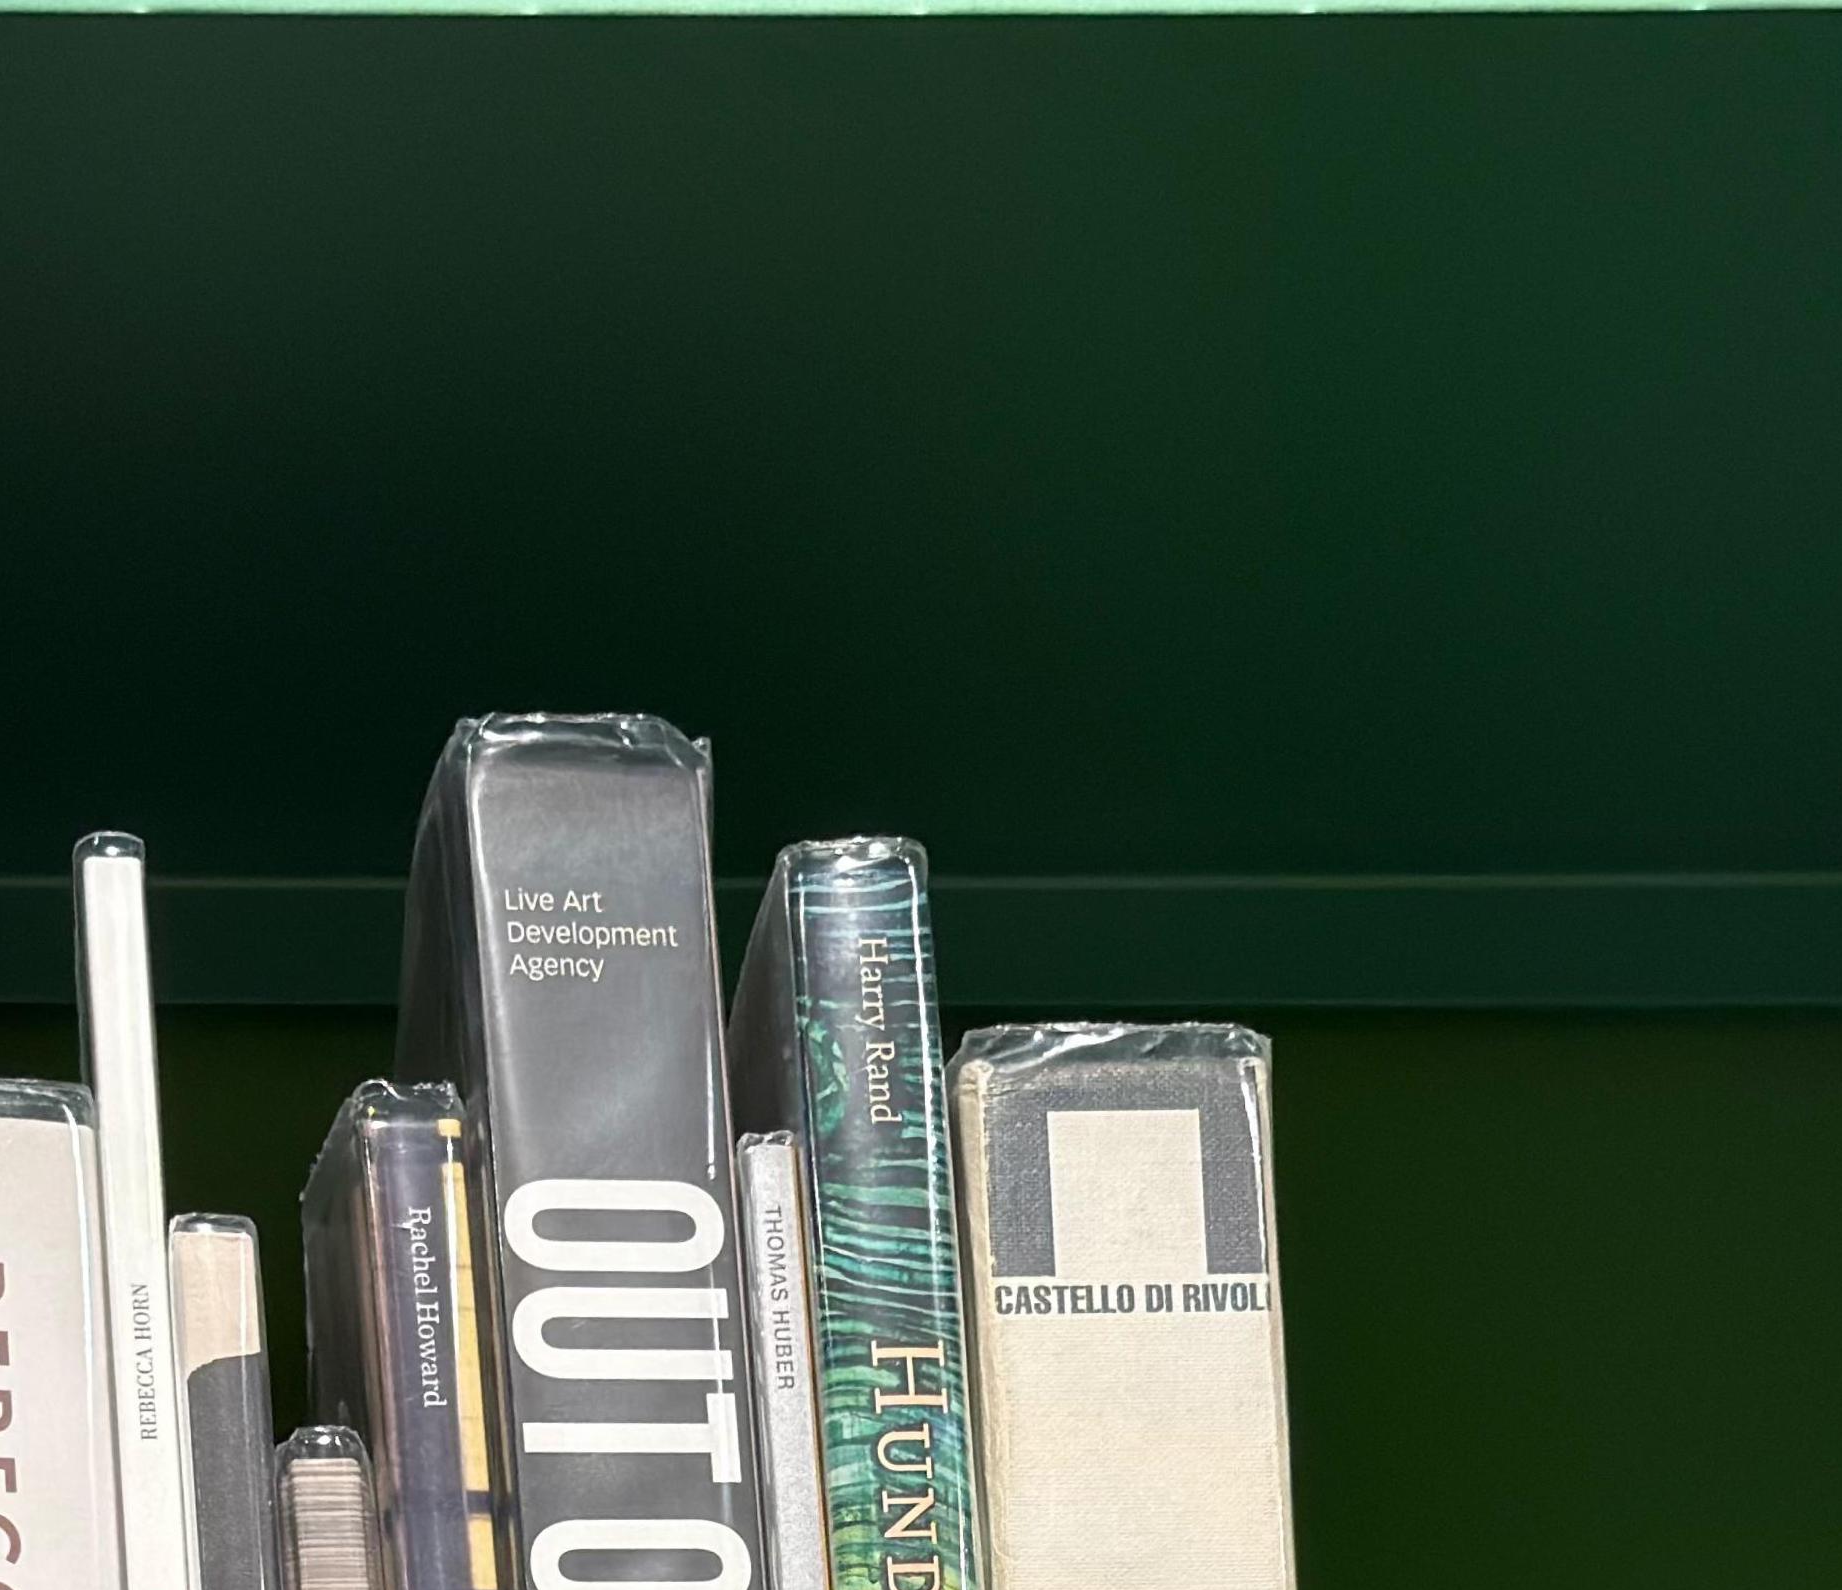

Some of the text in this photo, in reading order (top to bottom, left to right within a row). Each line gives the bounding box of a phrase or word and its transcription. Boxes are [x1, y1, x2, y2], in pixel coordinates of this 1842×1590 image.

[504, 888, 603, 913] Live Art
[507, 921, 677, 949] Development
[510, 954, 604, 982] Agency
[858, 937, 903, 1124] Harry Rand
[132, 1283, 158, 1440] REBECCA HORN
[408, 1206, 447, 1408] Rachel Howard
[504, 1179, 742, 1483] OUT
[764, 1205, 795, 1391] THOMAS HUBER
[994, 1284, 1135, 1315] CASTELLO
[1145, 1283, 1173, 1313] DI
